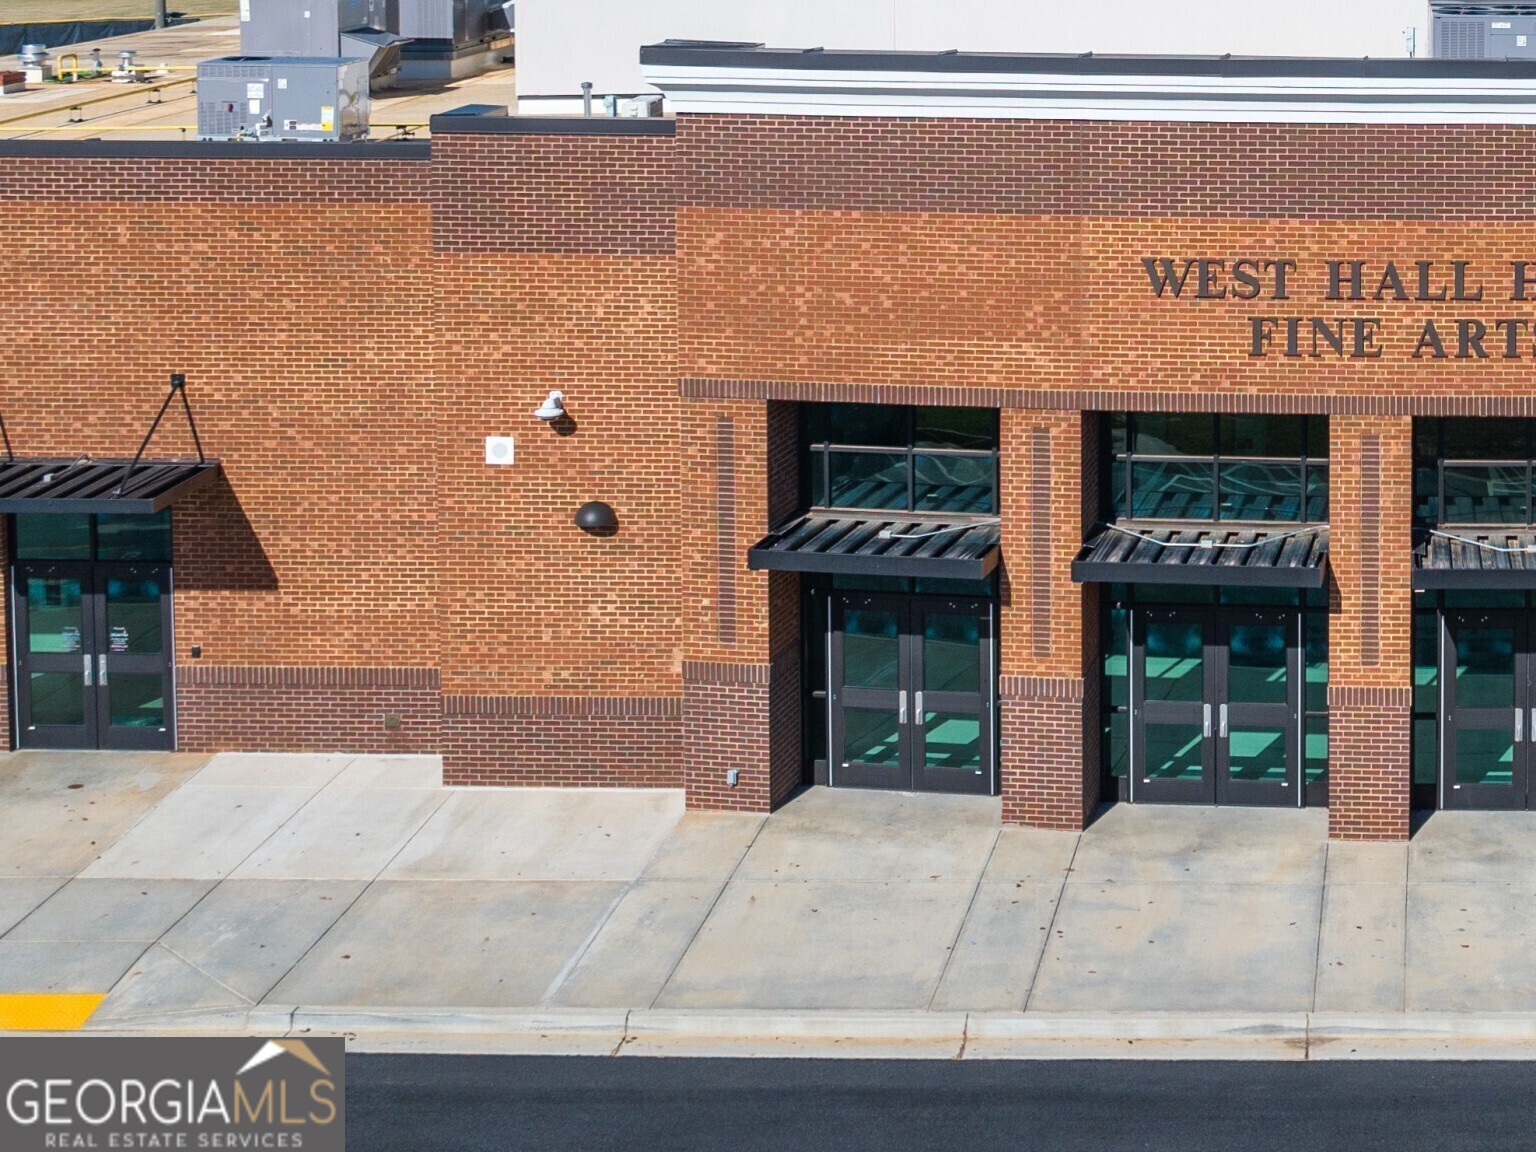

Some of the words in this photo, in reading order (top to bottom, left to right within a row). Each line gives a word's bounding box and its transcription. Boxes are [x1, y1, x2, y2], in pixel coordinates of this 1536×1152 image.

[1141, 257, 1297, 300] WEST
[1324, 259, 1484, 301] HALL
[1247, 316, 1383, 358] FINE
